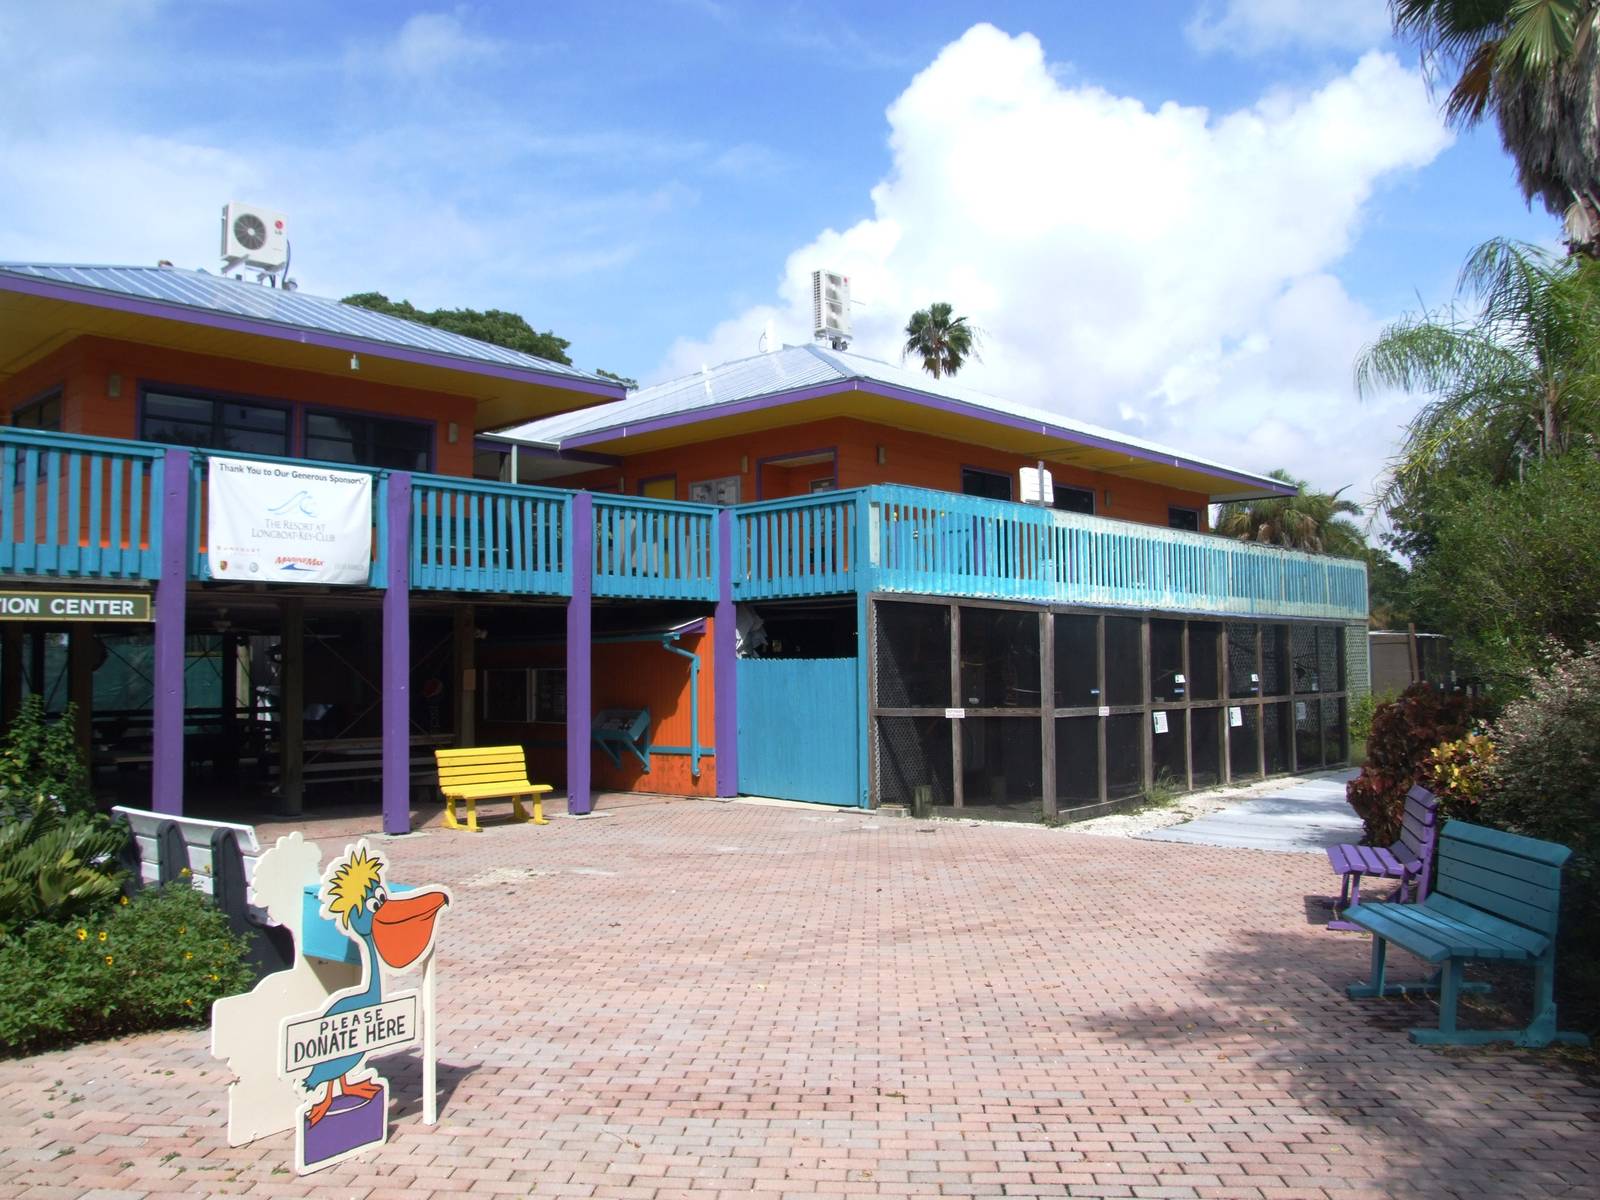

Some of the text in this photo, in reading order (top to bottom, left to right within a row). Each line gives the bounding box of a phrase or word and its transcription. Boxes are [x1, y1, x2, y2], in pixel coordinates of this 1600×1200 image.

[219, 463, 244, 473] Thank
[247, 466, 262, 476] You
[263, 468, 272, 476] to
[274, 469, 290, 478] Our
[292, 470, 327, 482] Generous
[265, 519, 326, 532] THE RESORT AT
[0, 597, 134, 615] ION CENTER
[320, 1008, 383, 1035] PLEASE
[294, 1015, 406, 1063] DONATE HERE
